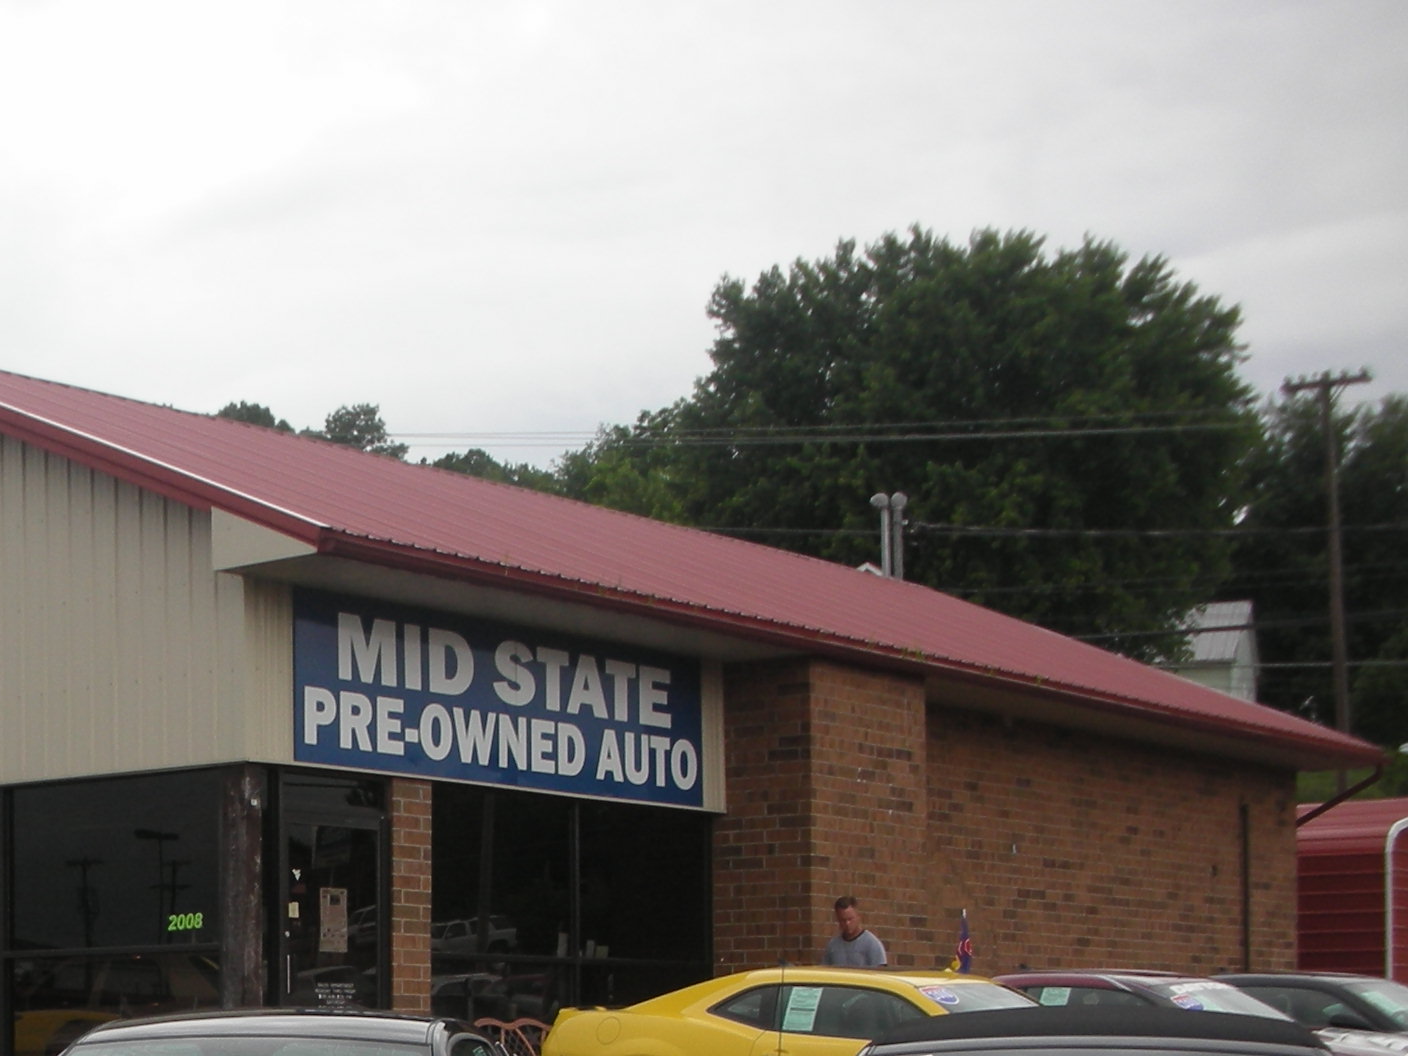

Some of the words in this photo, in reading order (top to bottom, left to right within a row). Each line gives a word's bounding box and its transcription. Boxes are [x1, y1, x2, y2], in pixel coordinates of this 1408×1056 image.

[337, 611, 475, 696] MID
[492, 640, 672, 729] STATE
[303, 685, 586, 777] PRE-OWNED
[595, 728, 698, 791] AUTO
[167, 912, 204, 931] 2008
